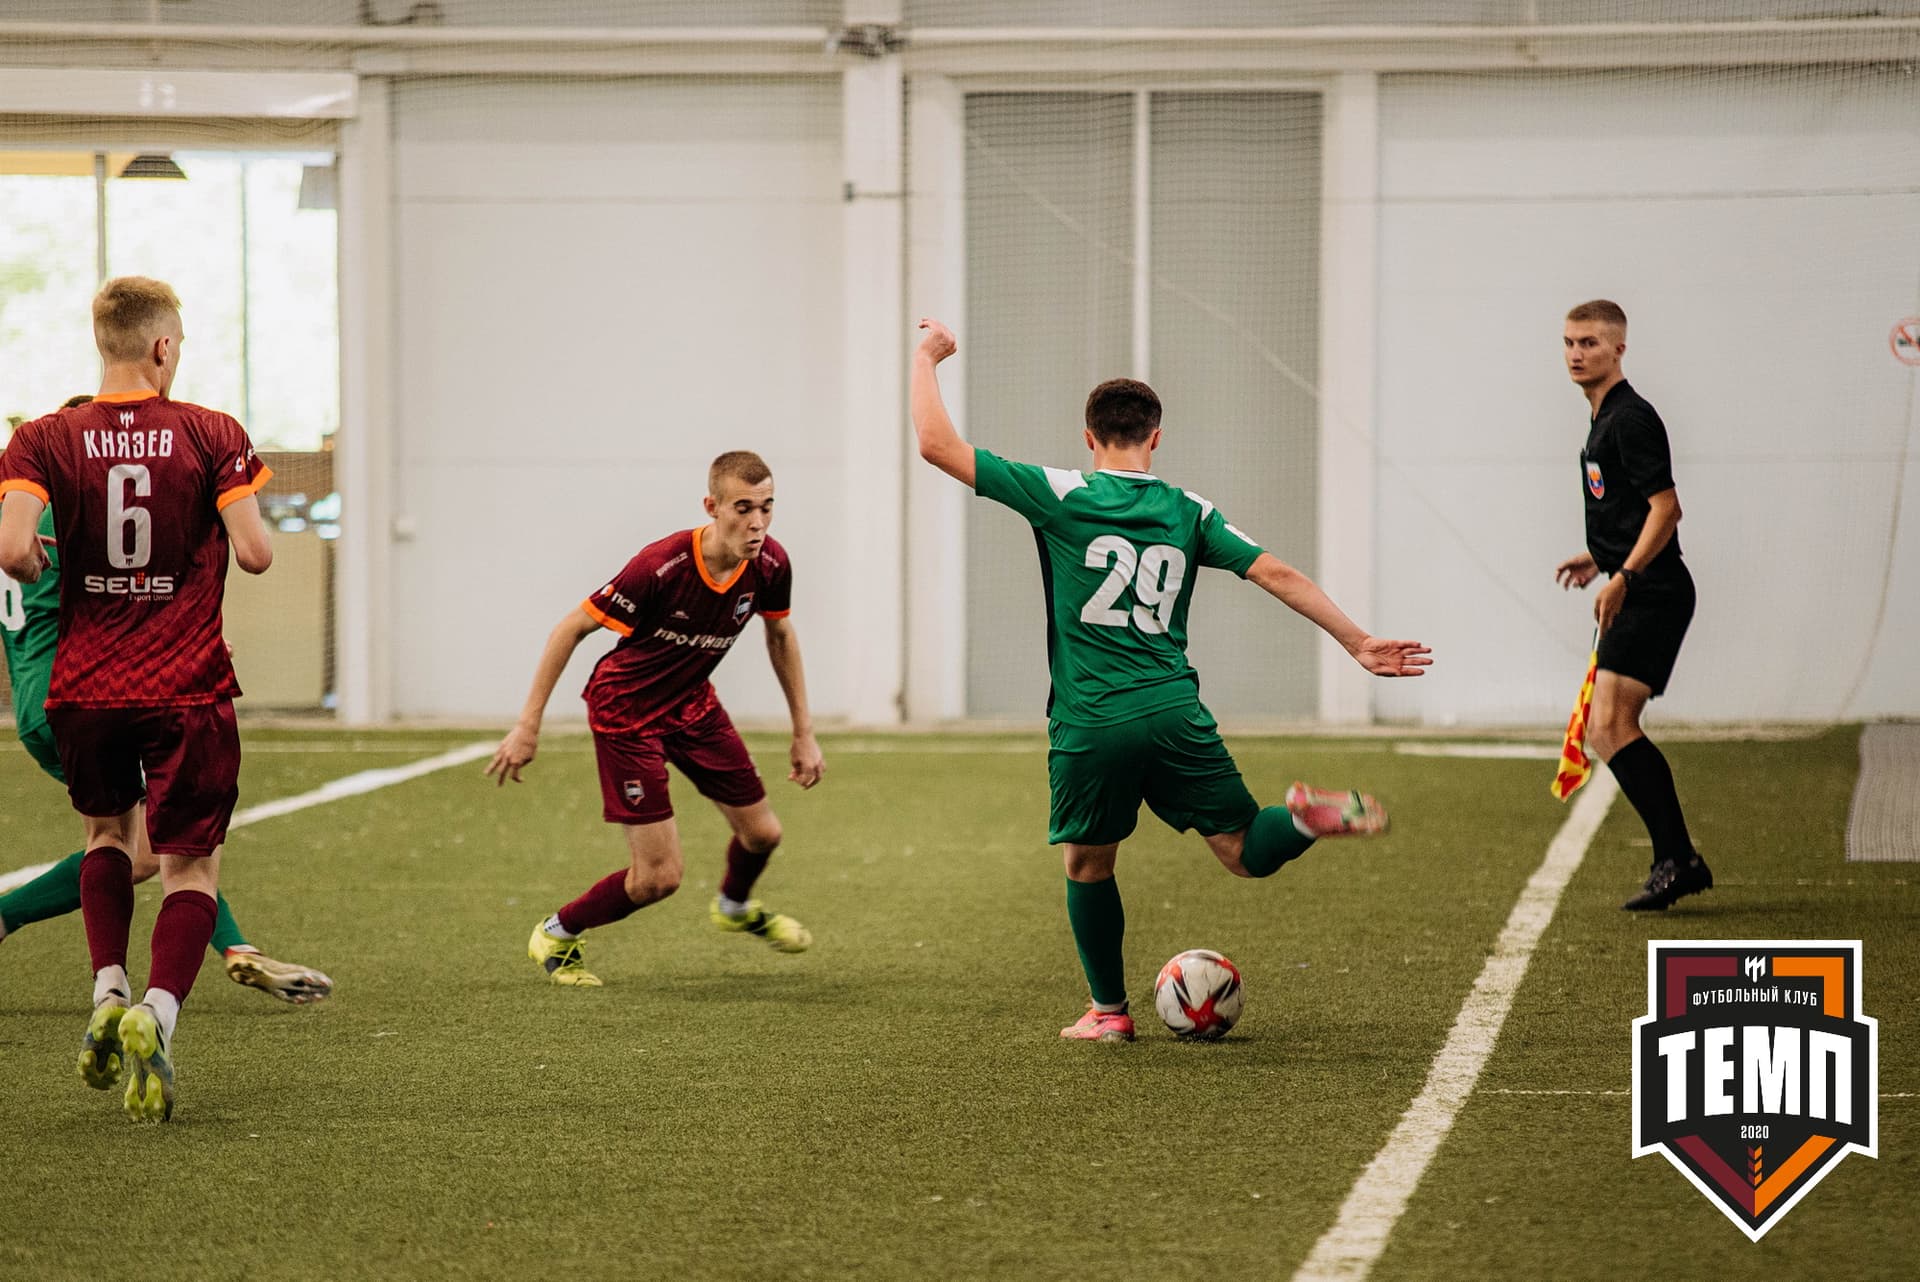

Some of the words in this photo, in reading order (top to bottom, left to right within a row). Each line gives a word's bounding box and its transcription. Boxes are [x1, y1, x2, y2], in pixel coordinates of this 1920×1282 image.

[83, 429, 174, 459] КНЯЗЕВ
[106, 463, 152, 569] 6
[611, 591, 637, 614] ПСБ
[1080, 534, 1186, 634] 29
